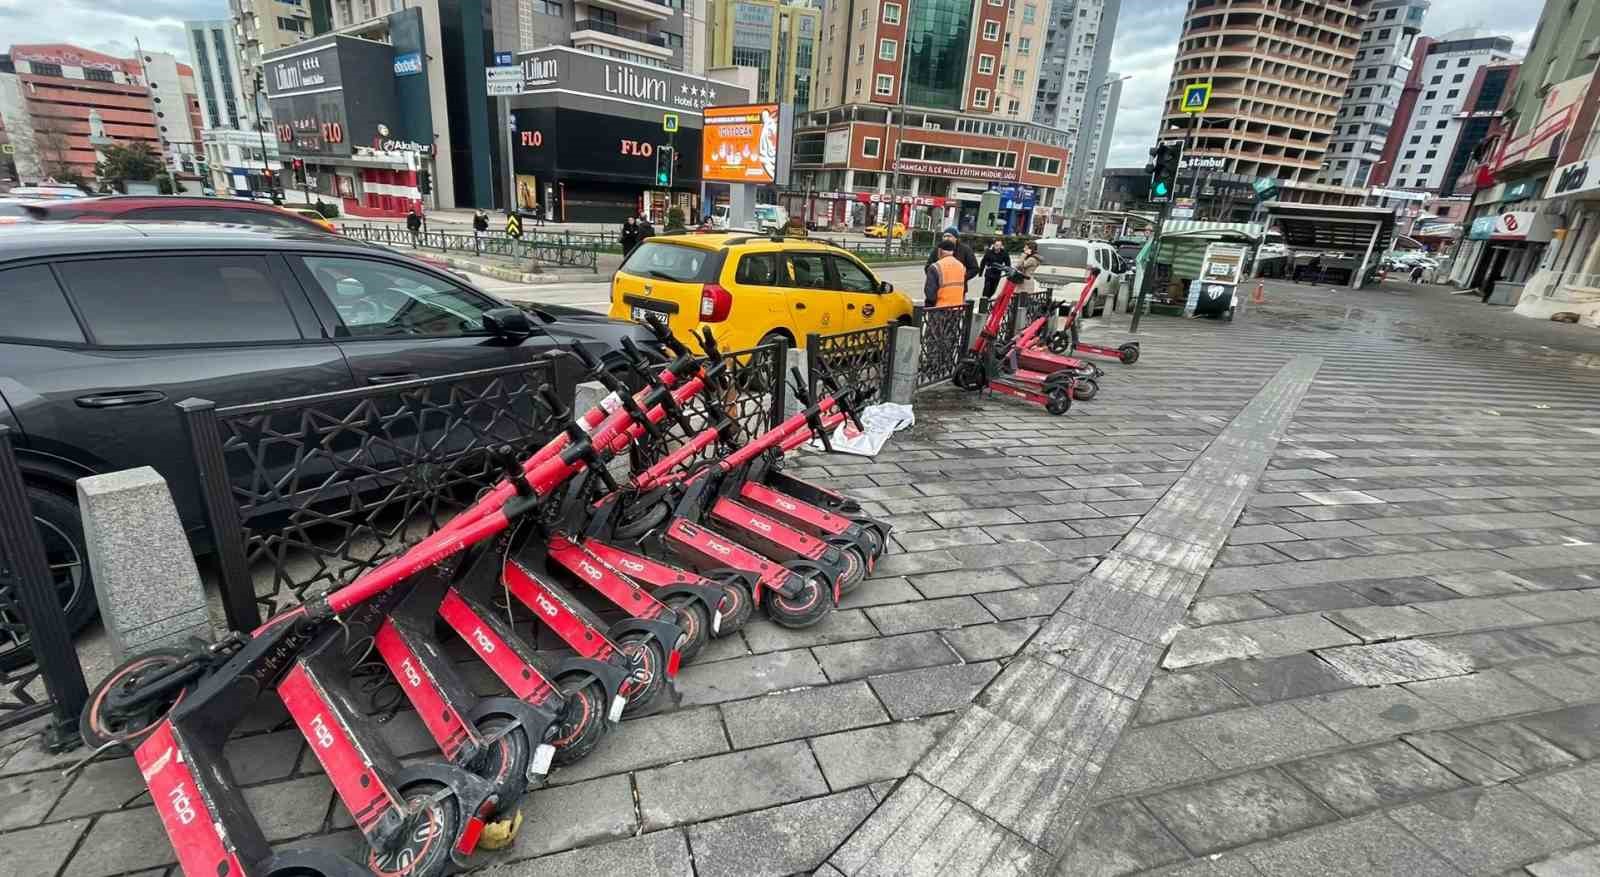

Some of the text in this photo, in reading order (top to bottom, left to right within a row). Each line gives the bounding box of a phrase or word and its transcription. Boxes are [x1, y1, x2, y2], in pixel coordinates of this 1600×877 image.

[525, 58, 557, 80] Lilium
[605, 64, 666, 103] Lilium
[321, 122, 342, 143] FLO
[521, 132, 542, 146] FLO
[621, 140, 653, 157] FLO
[579, 560, 602, 579] hop
[620, 558, 645, 572] hop
[536, 593, 558, 617] hop
[473, 626, 495, 653] hop
[400, 657, 421, 687] hop
[309, 713, 334, 748] hop
[168, 782, 196, 825] hop
